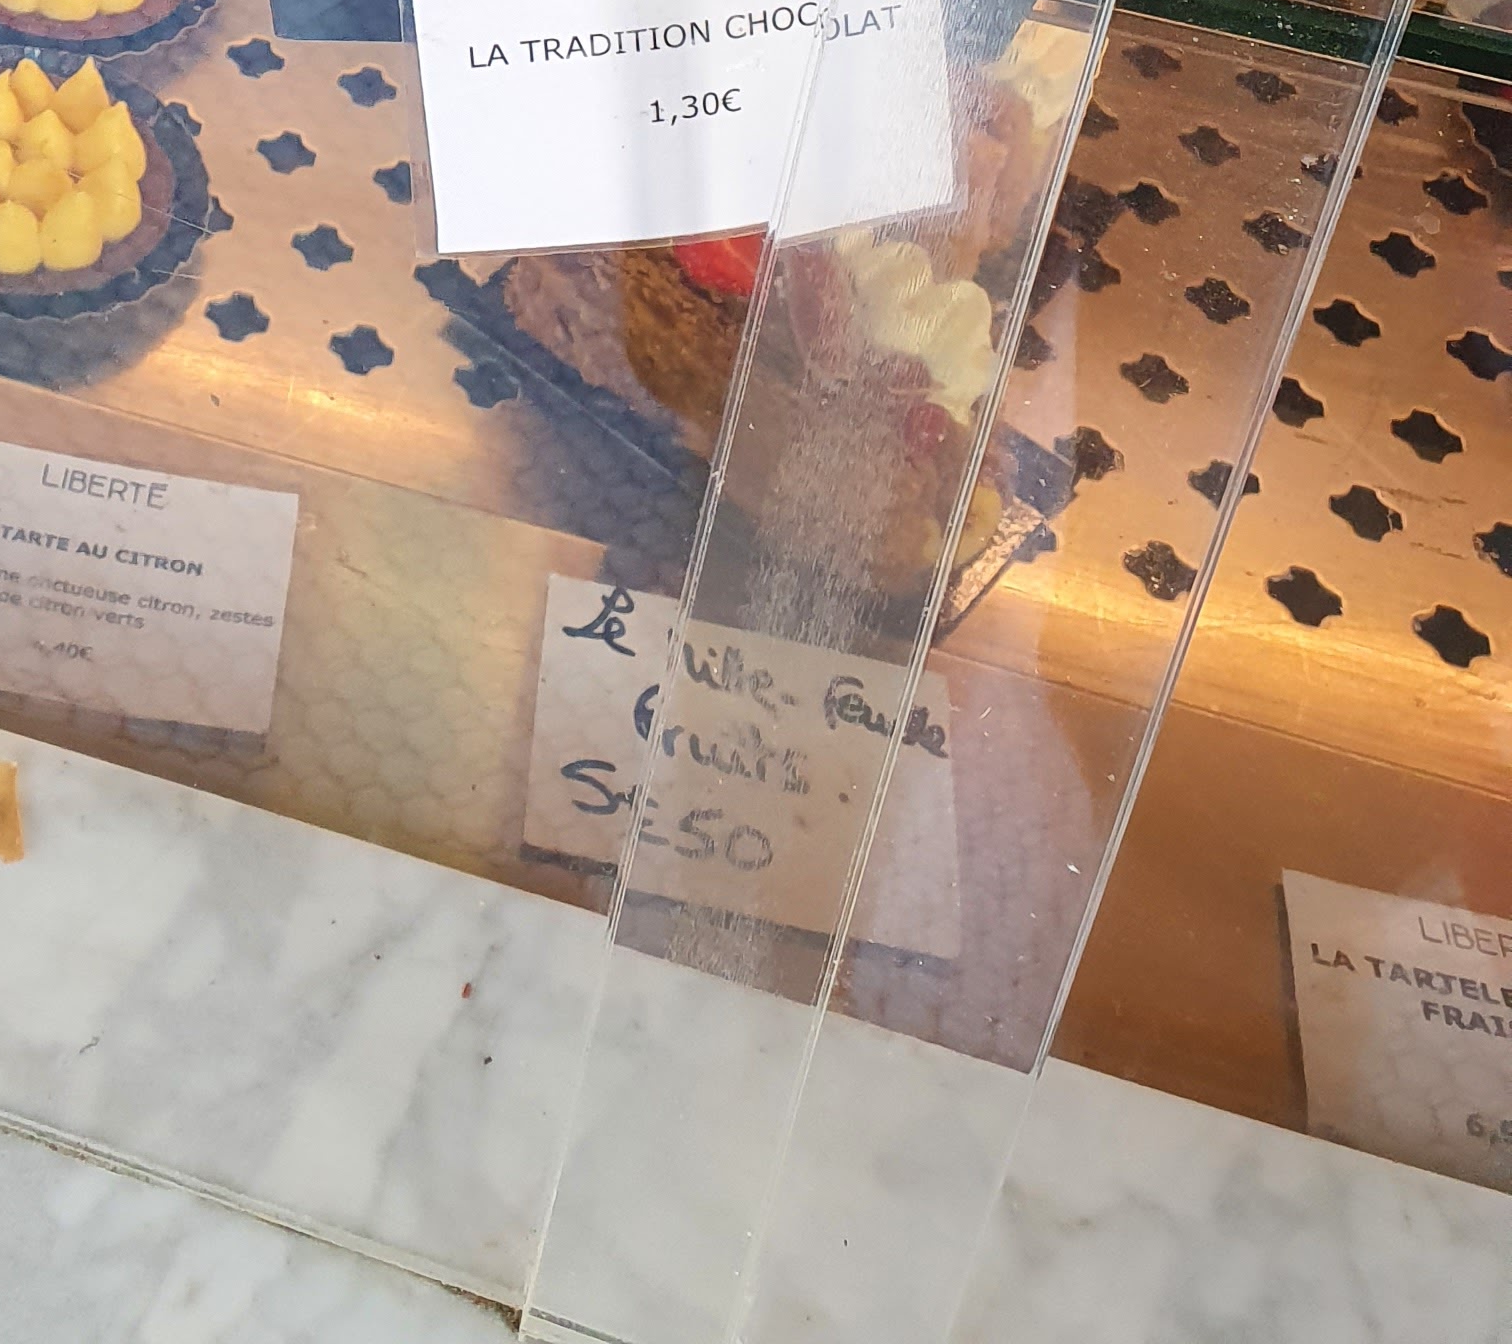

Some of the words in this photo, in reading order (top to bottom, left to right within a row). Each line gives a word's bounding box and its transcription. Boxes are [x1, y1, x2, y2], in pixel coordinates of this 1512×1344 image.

[468, 43, 509, 69] LA
[520, 19, 712, 64] TRADITION
[648, 87, 743, 126] 1,30€
[1, 523, 70, 552] TARTE
[75, 541, 108, 560] AU
[114, 548, 203, 577] CITRON
[94, 609, 145, 630] verts
[137, 594, 202, 621] citron,
[209, 608, 274, 628] zestes
[563, 585, 636, 658] Le
[1310, 942, 1356, 972] LA
